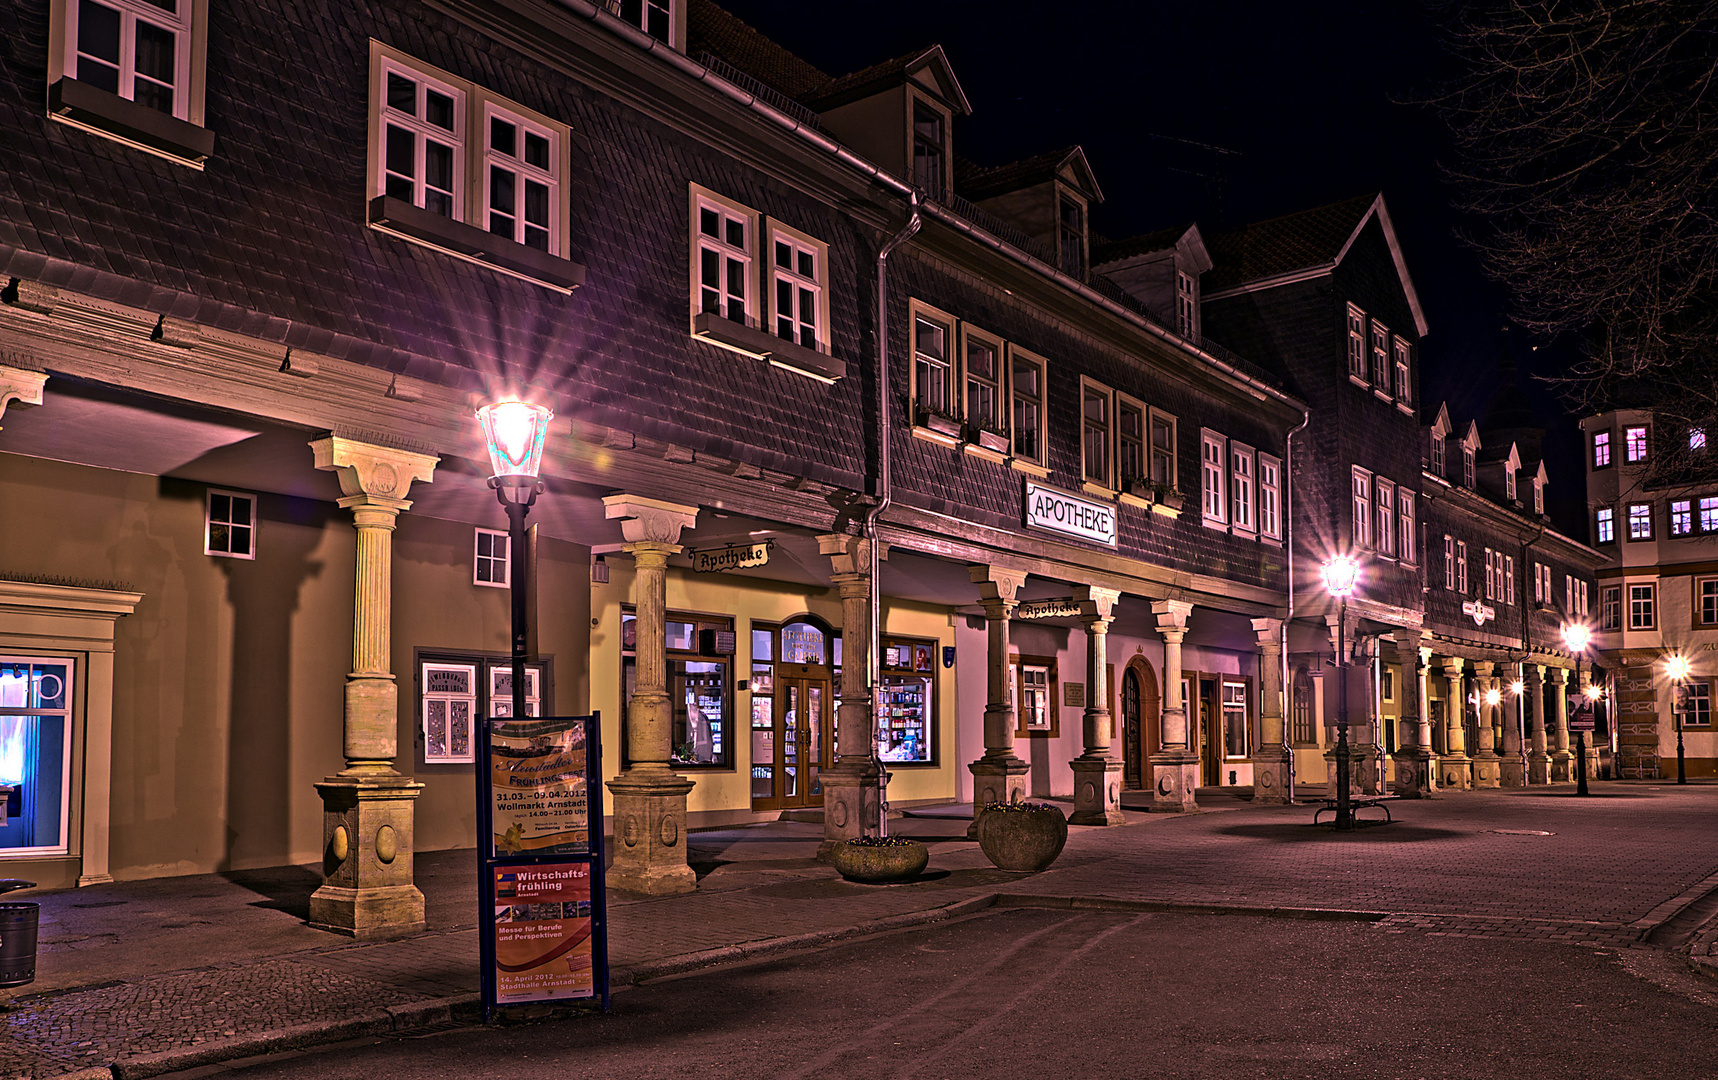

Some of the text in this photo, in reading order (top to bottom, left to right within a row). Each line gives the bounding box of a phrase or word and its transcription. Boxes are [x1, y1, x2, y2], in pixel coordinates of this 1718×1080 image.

[1034, 494, 1109, 534] APOTHEKE
[700, 547, 763, 571] Apotheke
[1025, 602, 1080, 618] Apotheke
[783, 630, 824, 643] APOTHEKE
[787, 650, 820, 662] GALERIE
[432, 684, 463, 692] PASSBLDER
[495, 752, 573, 773] Arnstädter
[509, 769, 585, 787] FRÜHLINGSFEST
[497, 799, 586, 811] Wollmarkt Arnstadt
[517, 870, 588, 881] Wirtschafts-
[517, 881, 562, 891] frühling
[515, 931, 562, 941] Perspektiven
[500, 982, 540, 990] Stadthalle
[542, 979, 575, 987] Arnstadt
[514, 975, 533, 983] April
